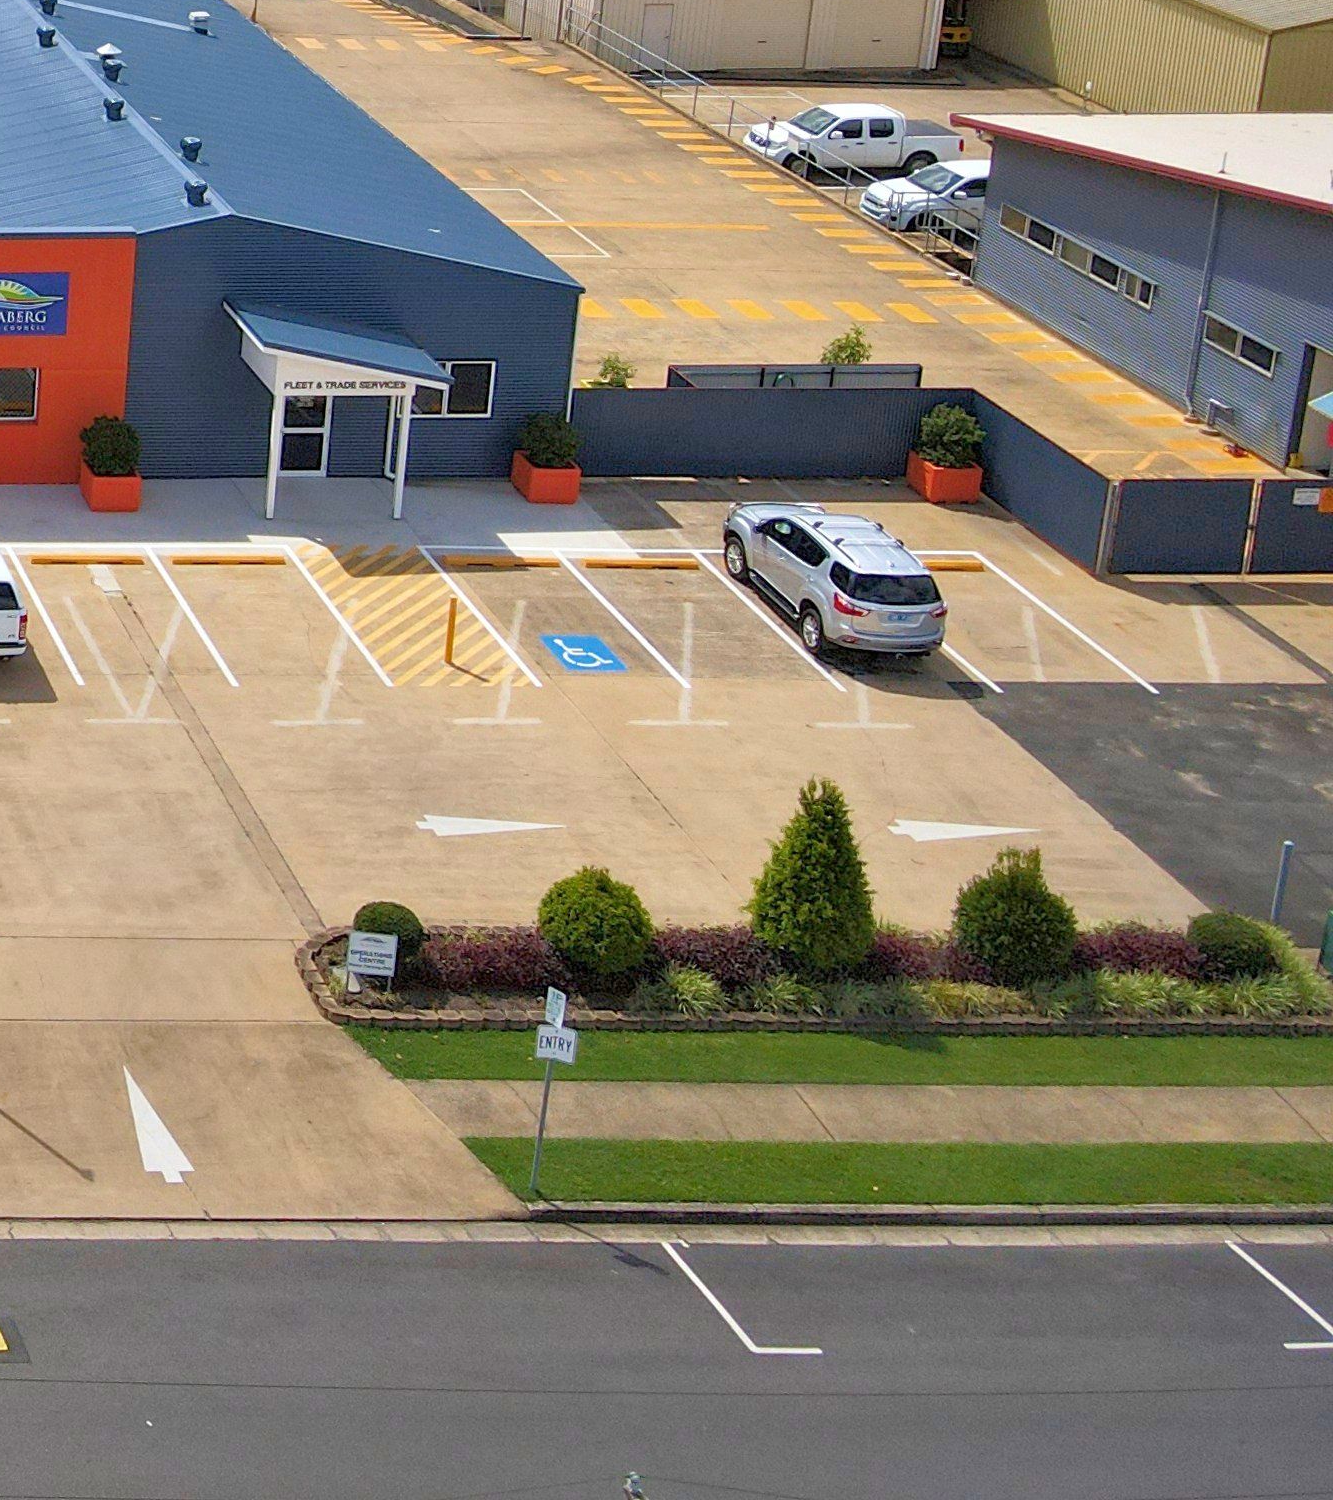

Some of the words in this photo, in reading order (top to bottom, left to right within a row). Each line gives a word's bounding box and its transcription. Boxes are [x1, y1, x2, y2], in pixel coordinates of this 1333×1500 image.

[284, 381, 313, 389] FLEET
[316, 381, 322, 389] &
[325, 381, 357, 389] TRADE
[359, 381, 406, 389] SERVICES
[539, 1035, 572, 1053] ENTRY
